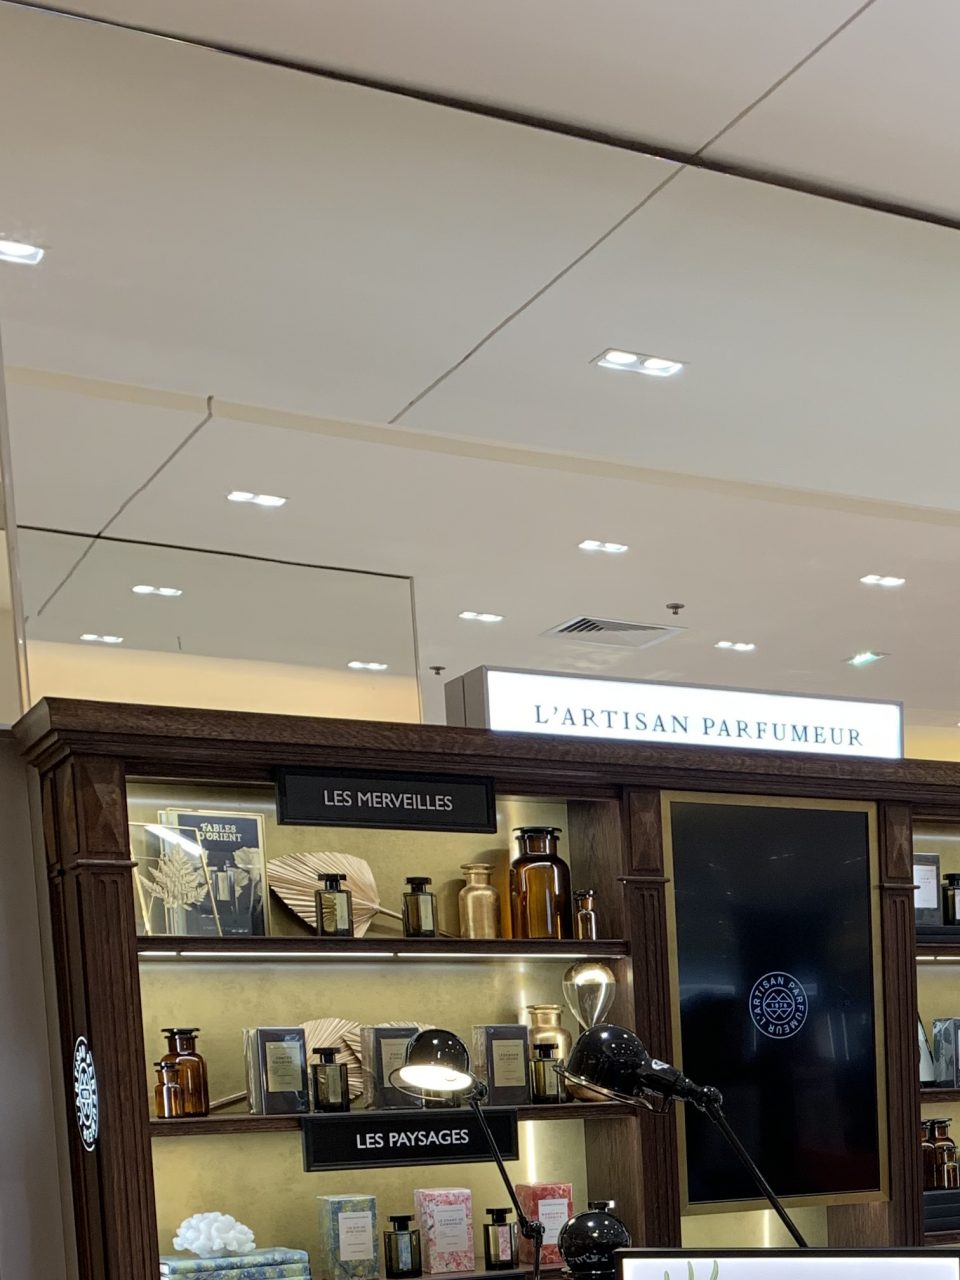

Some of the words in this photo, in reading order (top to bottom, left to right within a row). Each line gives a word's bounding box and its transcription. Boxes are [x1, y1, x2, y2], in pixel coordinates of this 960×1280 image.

[533, 704, 690, 734] L'ARTISAN
[702, 717, 864, 747] PARFUMEUR
[324, 789, 352, 806] LES
[357, 791, 453, 811] MERVEILLES
[768, 981, 805, 1034] PARFUMEUR
[356, 1133, 384, 1149] LES
[388, 1129, 469, 1147] PAYSAGES
